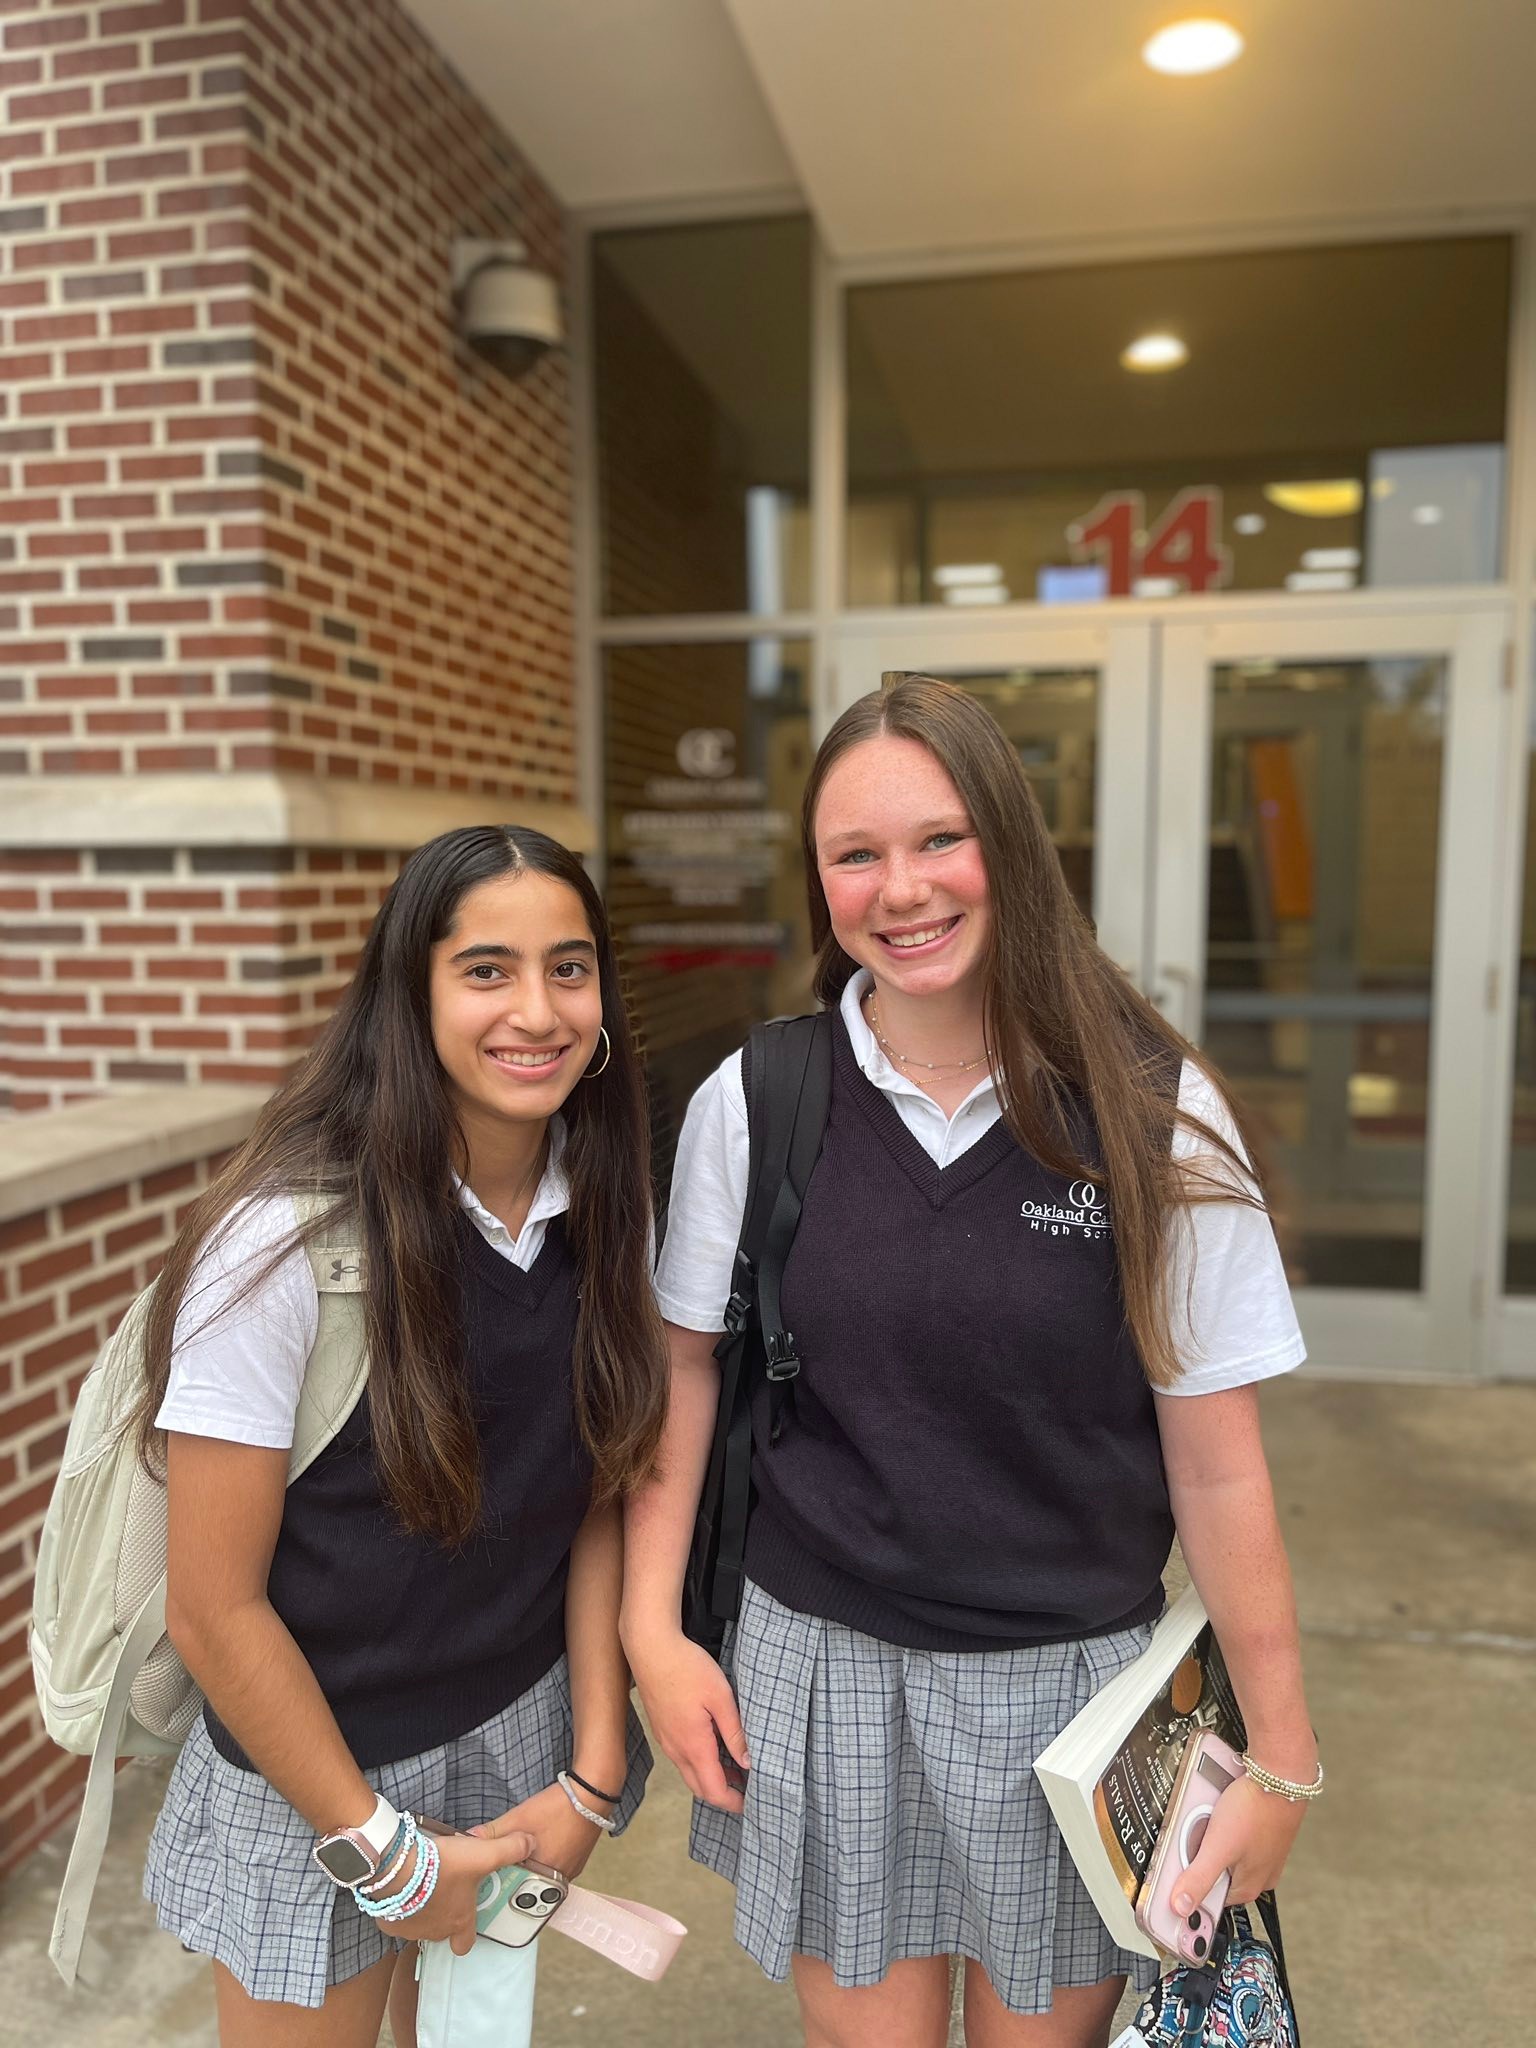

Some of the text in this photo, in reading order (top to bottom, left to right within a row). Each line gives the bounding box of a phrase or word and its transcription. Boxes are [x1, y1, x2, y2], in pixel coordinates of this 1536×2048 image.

[1069, 487, 1231, 598] 14
[1021, 1200, 1085, 1223] Oakland
[1030, 1219, 1070, 1236] High
[1108, 1774, 1146, 1863] OF RIVALS
[1139, 1797, 1153, 1822] TIMES
